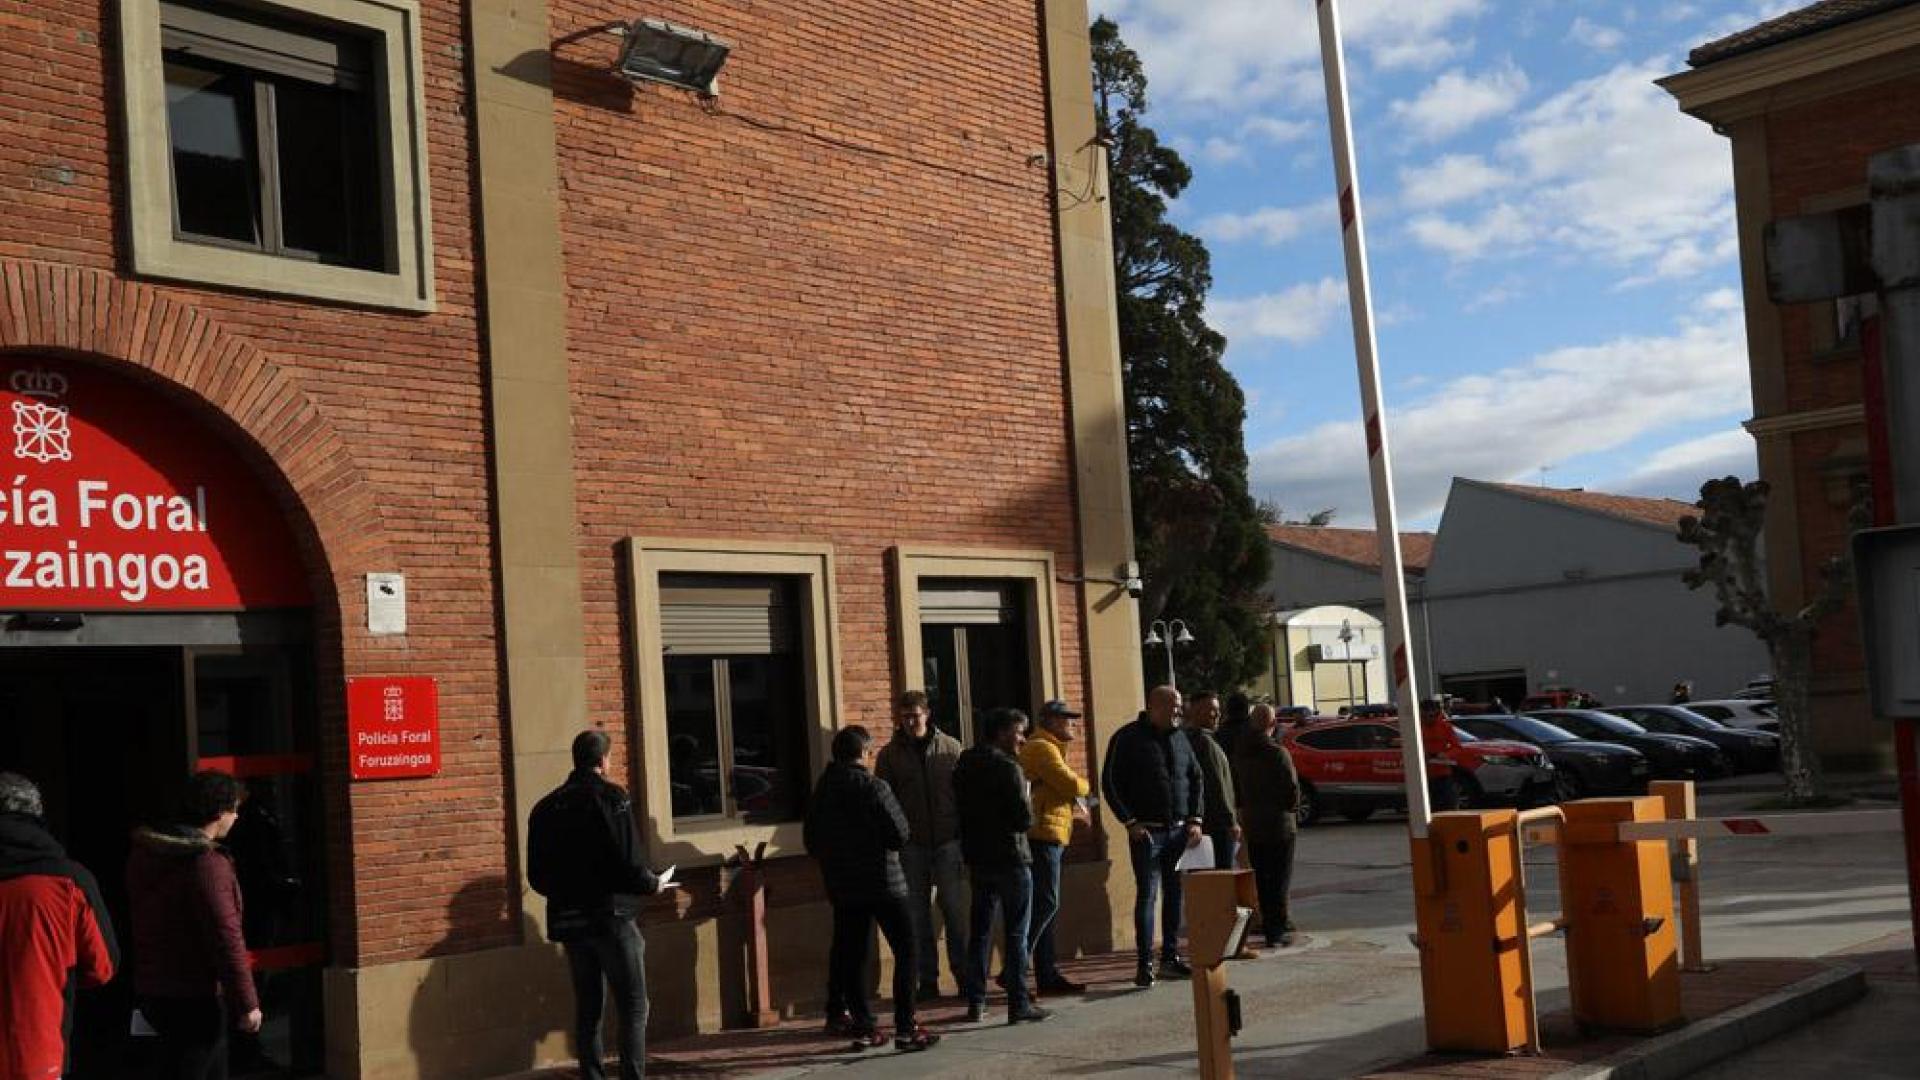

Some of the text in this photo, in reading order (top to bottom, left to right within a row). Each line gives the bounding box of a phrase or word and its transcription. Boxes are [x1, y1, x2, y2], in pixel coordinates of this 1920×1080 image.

[0, 474, 208, 532] ía Foral
[5, 539, 210, 602] zaingoa
[401, 729, 431, 744] Foral
[359, 752, 432, 768] Foruzaingoa
